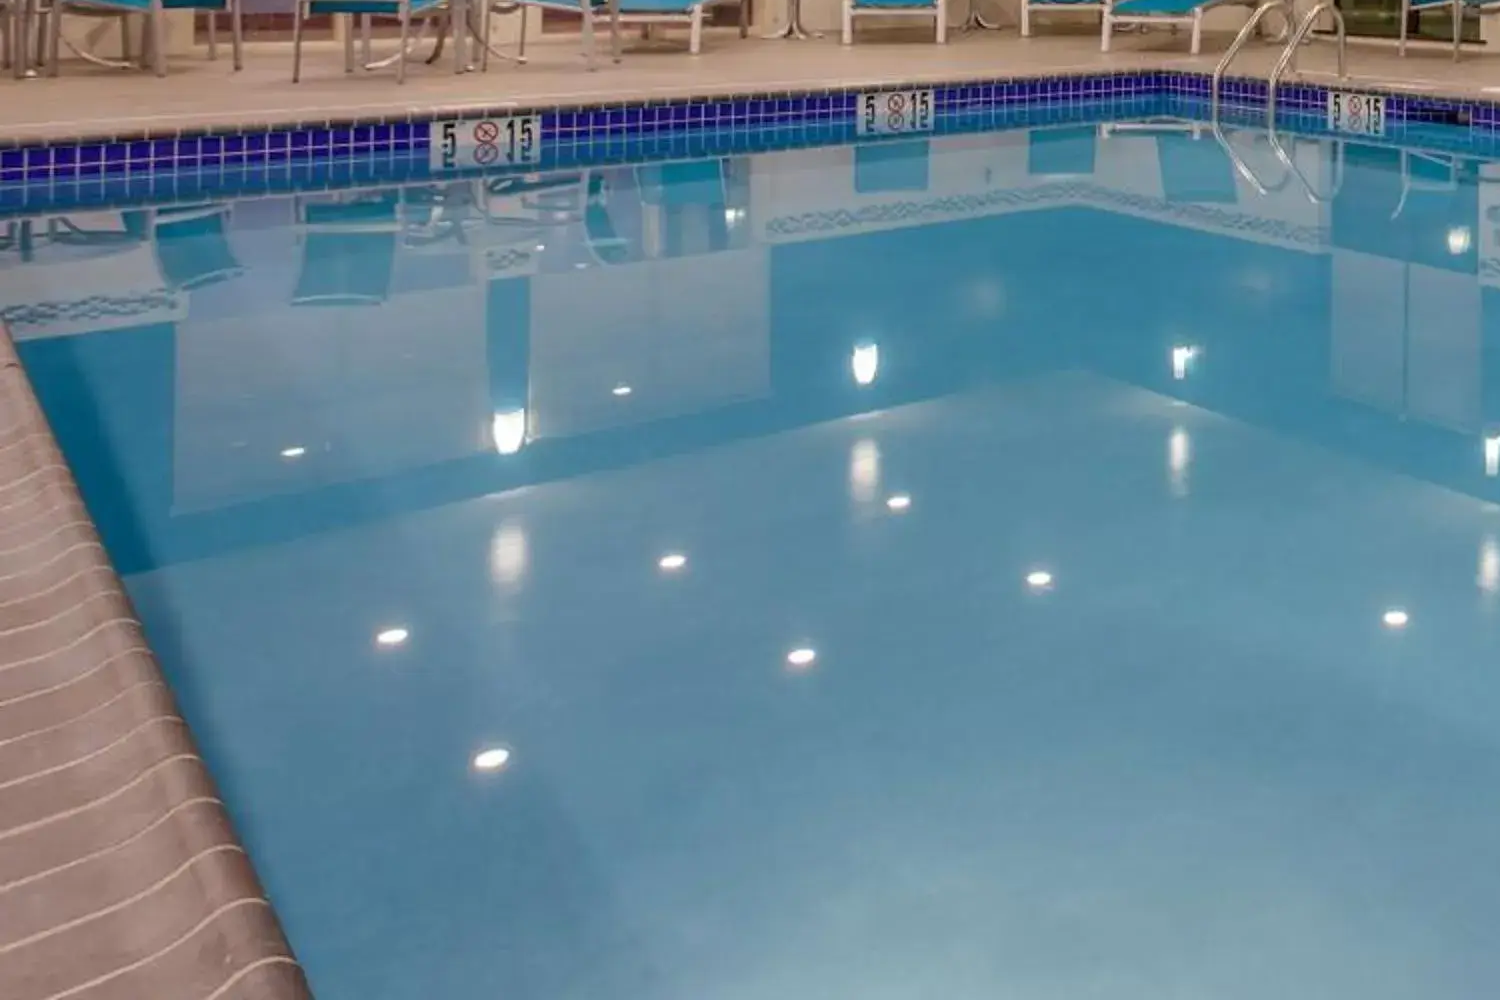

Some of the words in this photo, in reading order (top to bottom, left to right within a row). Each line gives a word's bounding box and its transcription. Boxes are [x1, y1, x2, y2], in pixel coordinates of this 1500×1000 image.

[866, 95, 875, 115] 5
[1333, 94, 1341, 117] 5
[443, 122, 456, 147] 5
